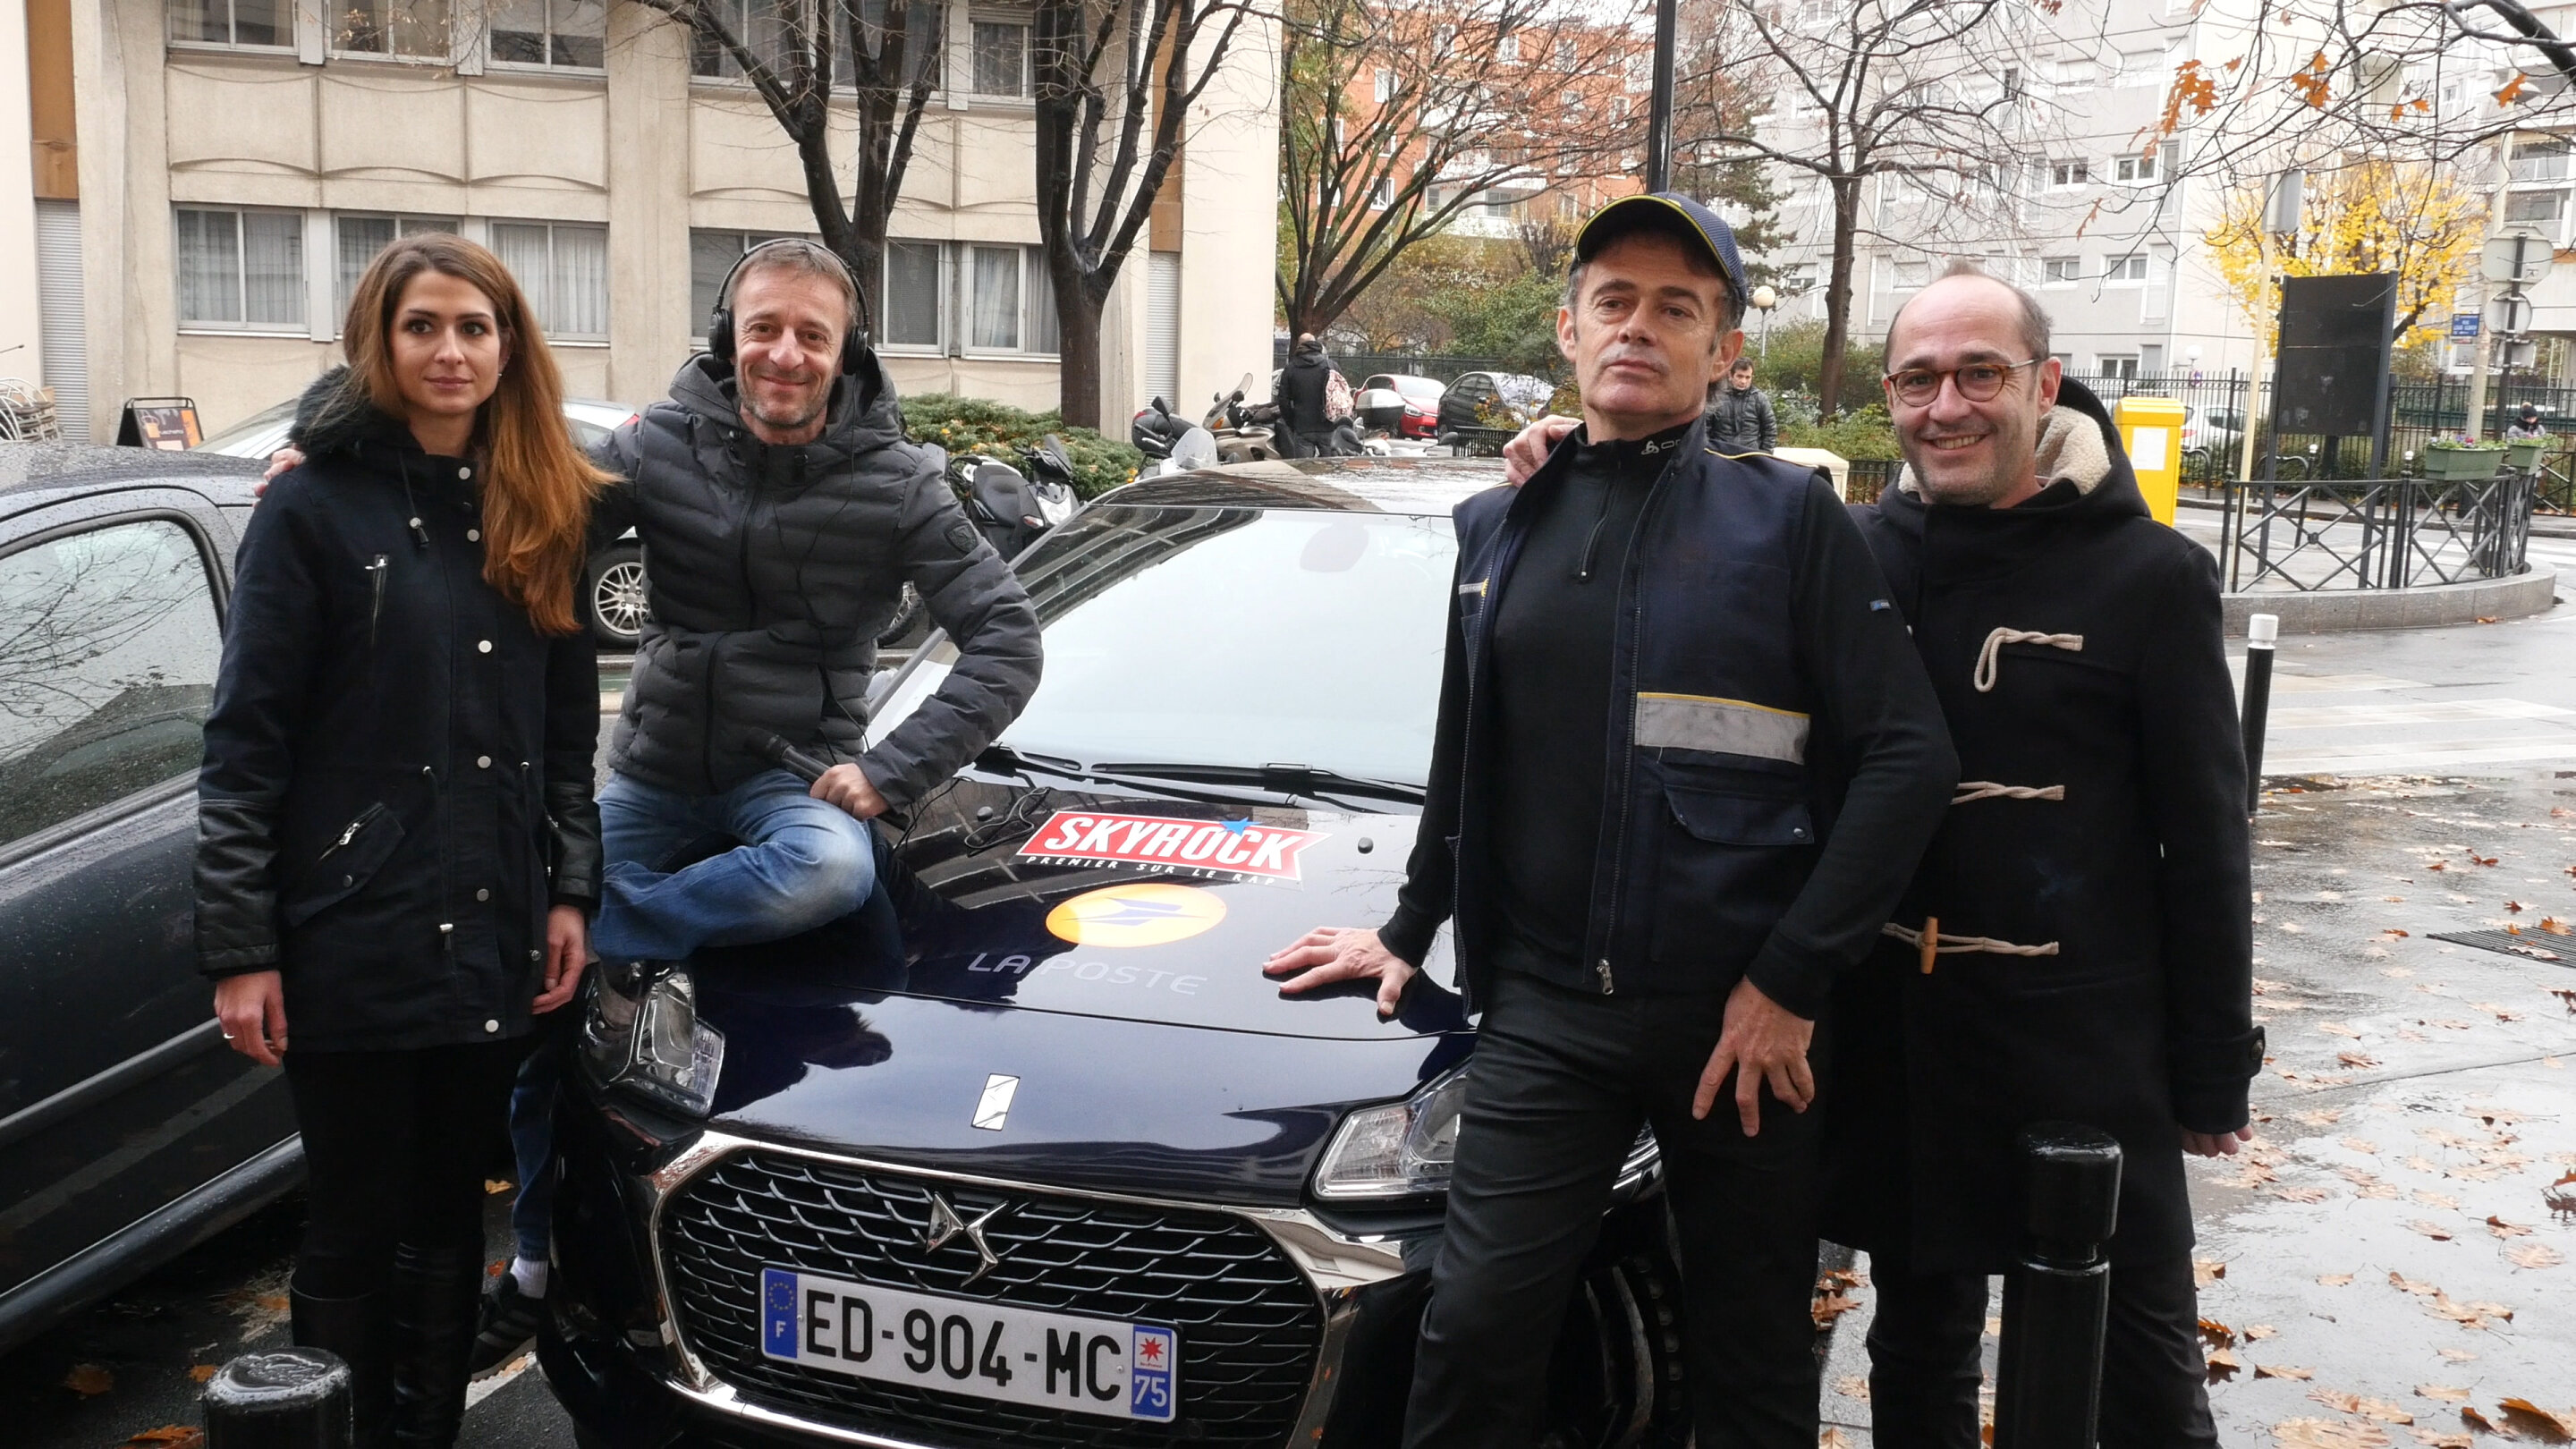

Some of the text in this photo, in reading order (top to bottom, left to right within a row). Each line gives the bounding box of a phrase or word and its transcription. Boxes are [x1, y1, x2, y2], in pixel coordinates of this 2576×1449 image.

[1043, 817, 1305, 871] SKYROCK
[1026, 856, 1275, 886] PREMIER SUR LE RAP
[967, 953, 1208, 996] LA POSTE
[775, 1320, 786, 1338] F
[806, 1289, 1122, 1402] ED-904-MC
[1134, 1375, 1167, 1407] 75
